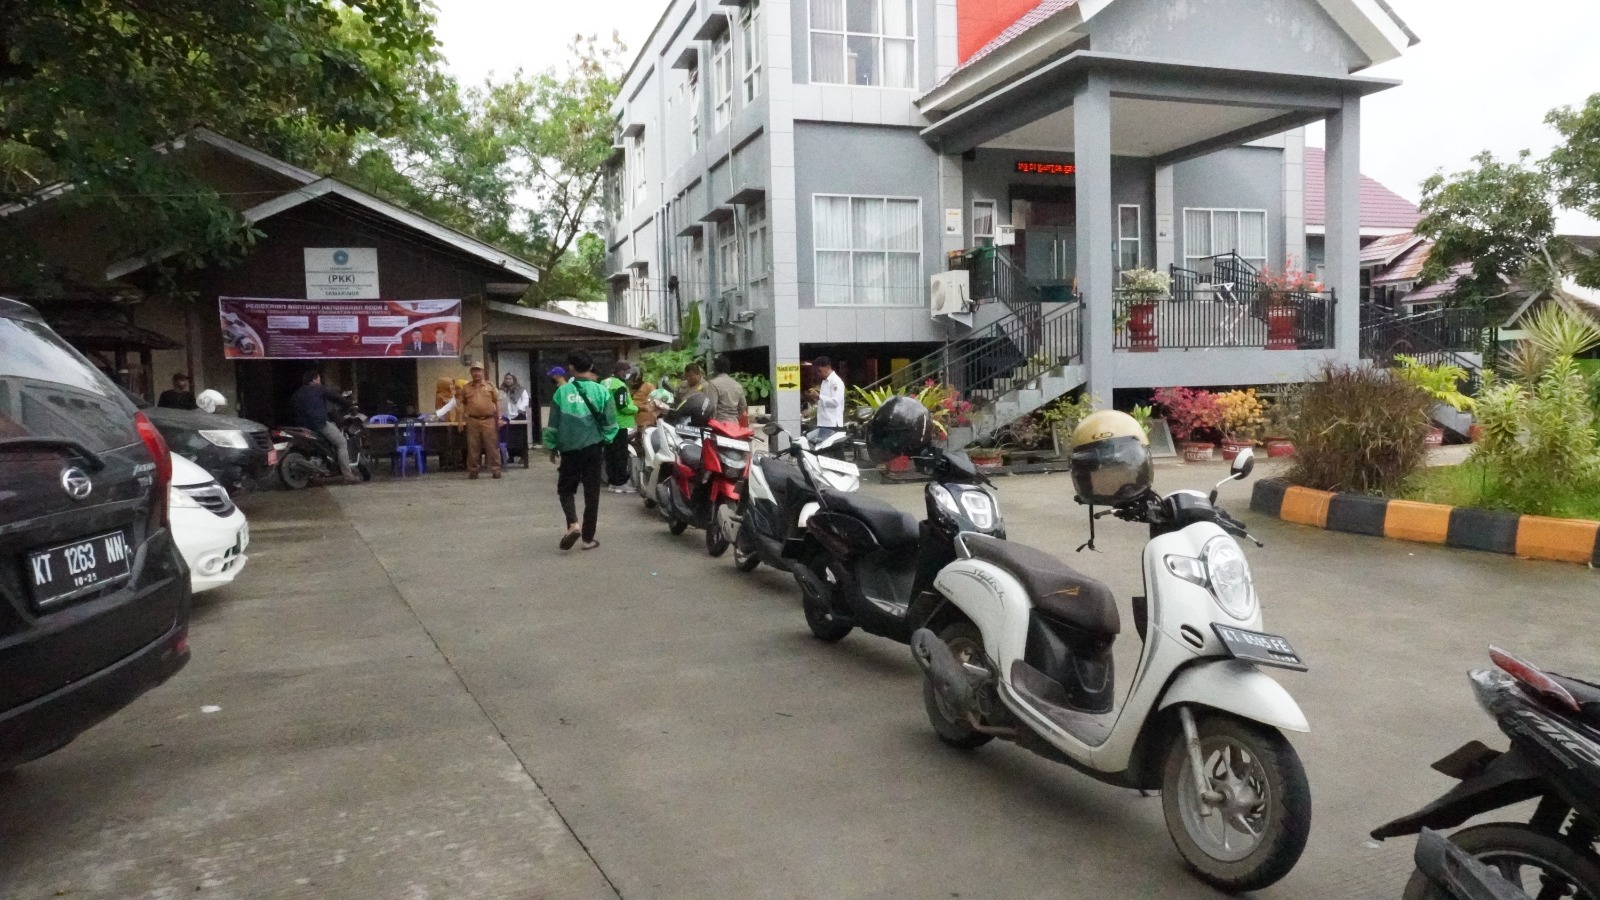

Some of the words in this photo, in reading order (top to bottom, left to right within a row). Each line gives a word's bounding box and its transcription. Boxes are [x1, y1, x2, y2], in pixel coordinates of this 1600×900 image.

[328, 274, 356, 284] (PKK)
[32, 553, 52, 586] KT
[64, 542, 96, 575] 1263
[104, 535, 125, 564] NN
[1221, 628, 1240, 642] KT
[1270, 639, 1291, 653] FE
